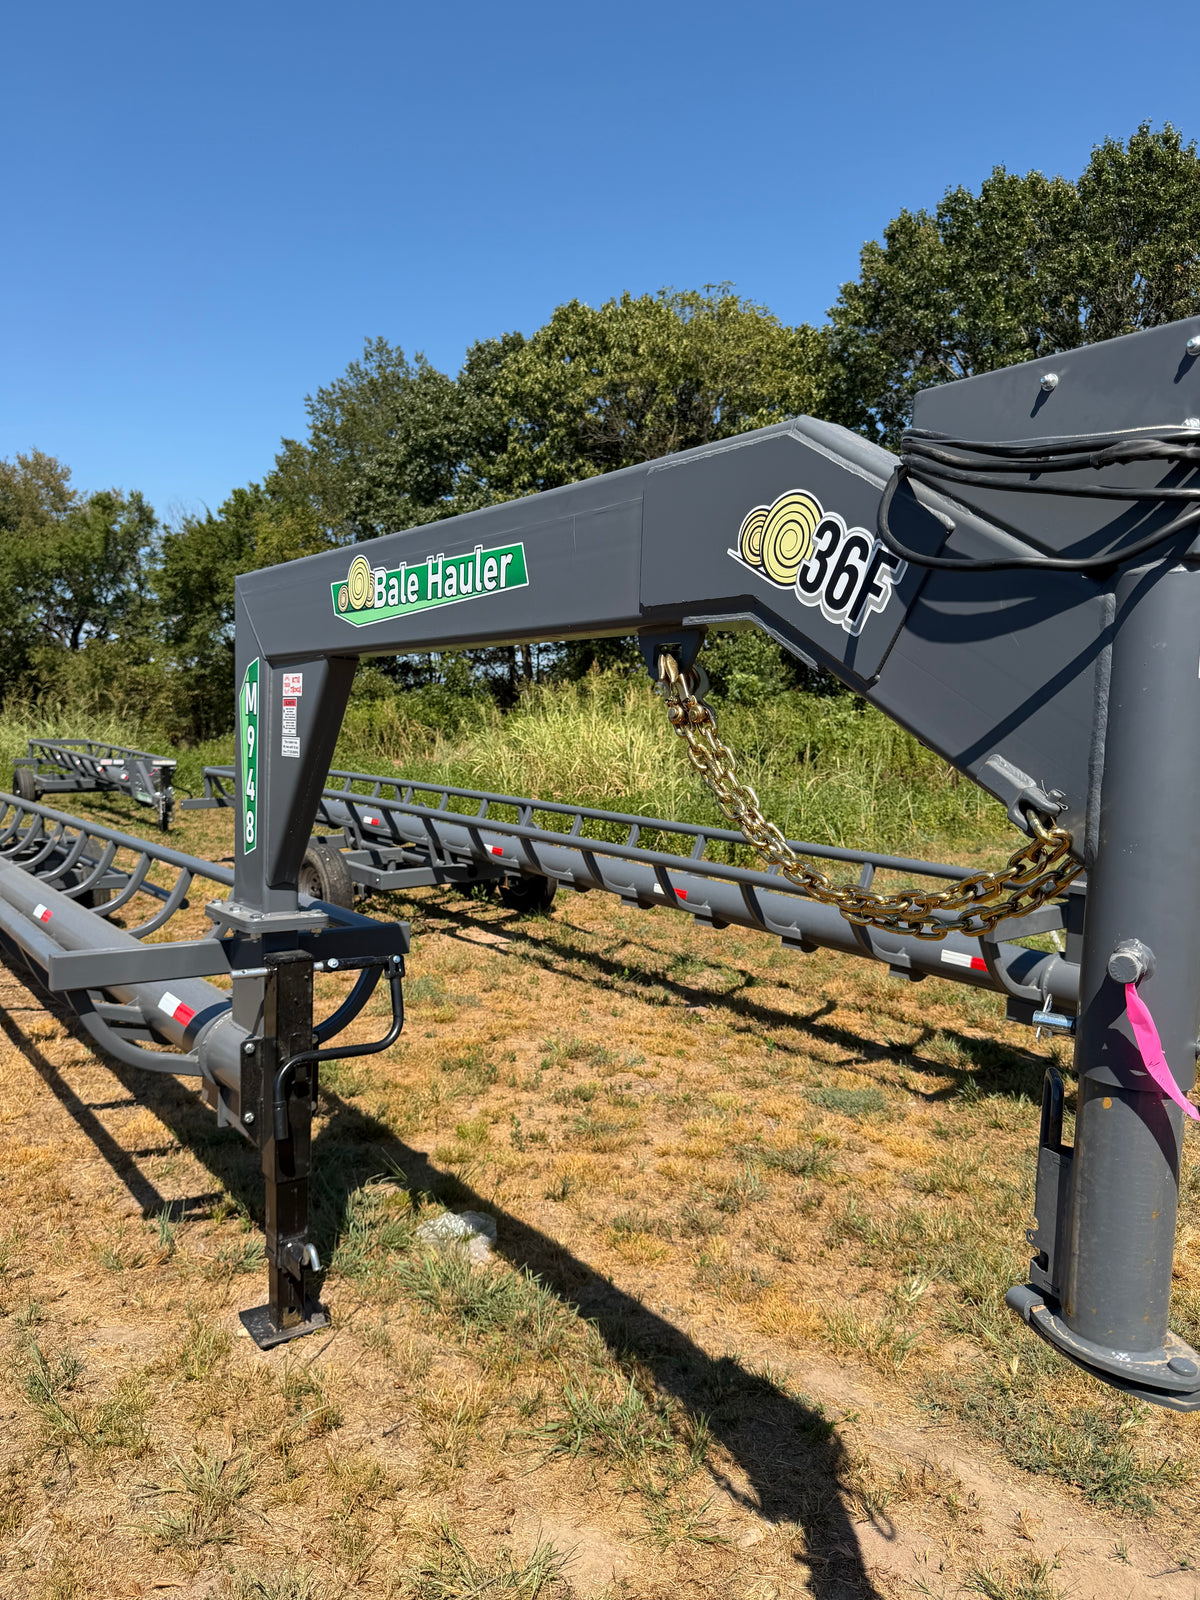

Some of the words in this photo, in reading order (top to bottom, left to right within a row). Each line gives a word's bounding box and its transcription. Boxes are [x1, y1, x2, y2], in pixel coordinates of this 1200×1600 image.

[373, 569, 419, 608] Bale
[426, 547, 514, 600] Hauler
[798, 519, 901, 623] 36F
[244, 681, 258, 844] M948
